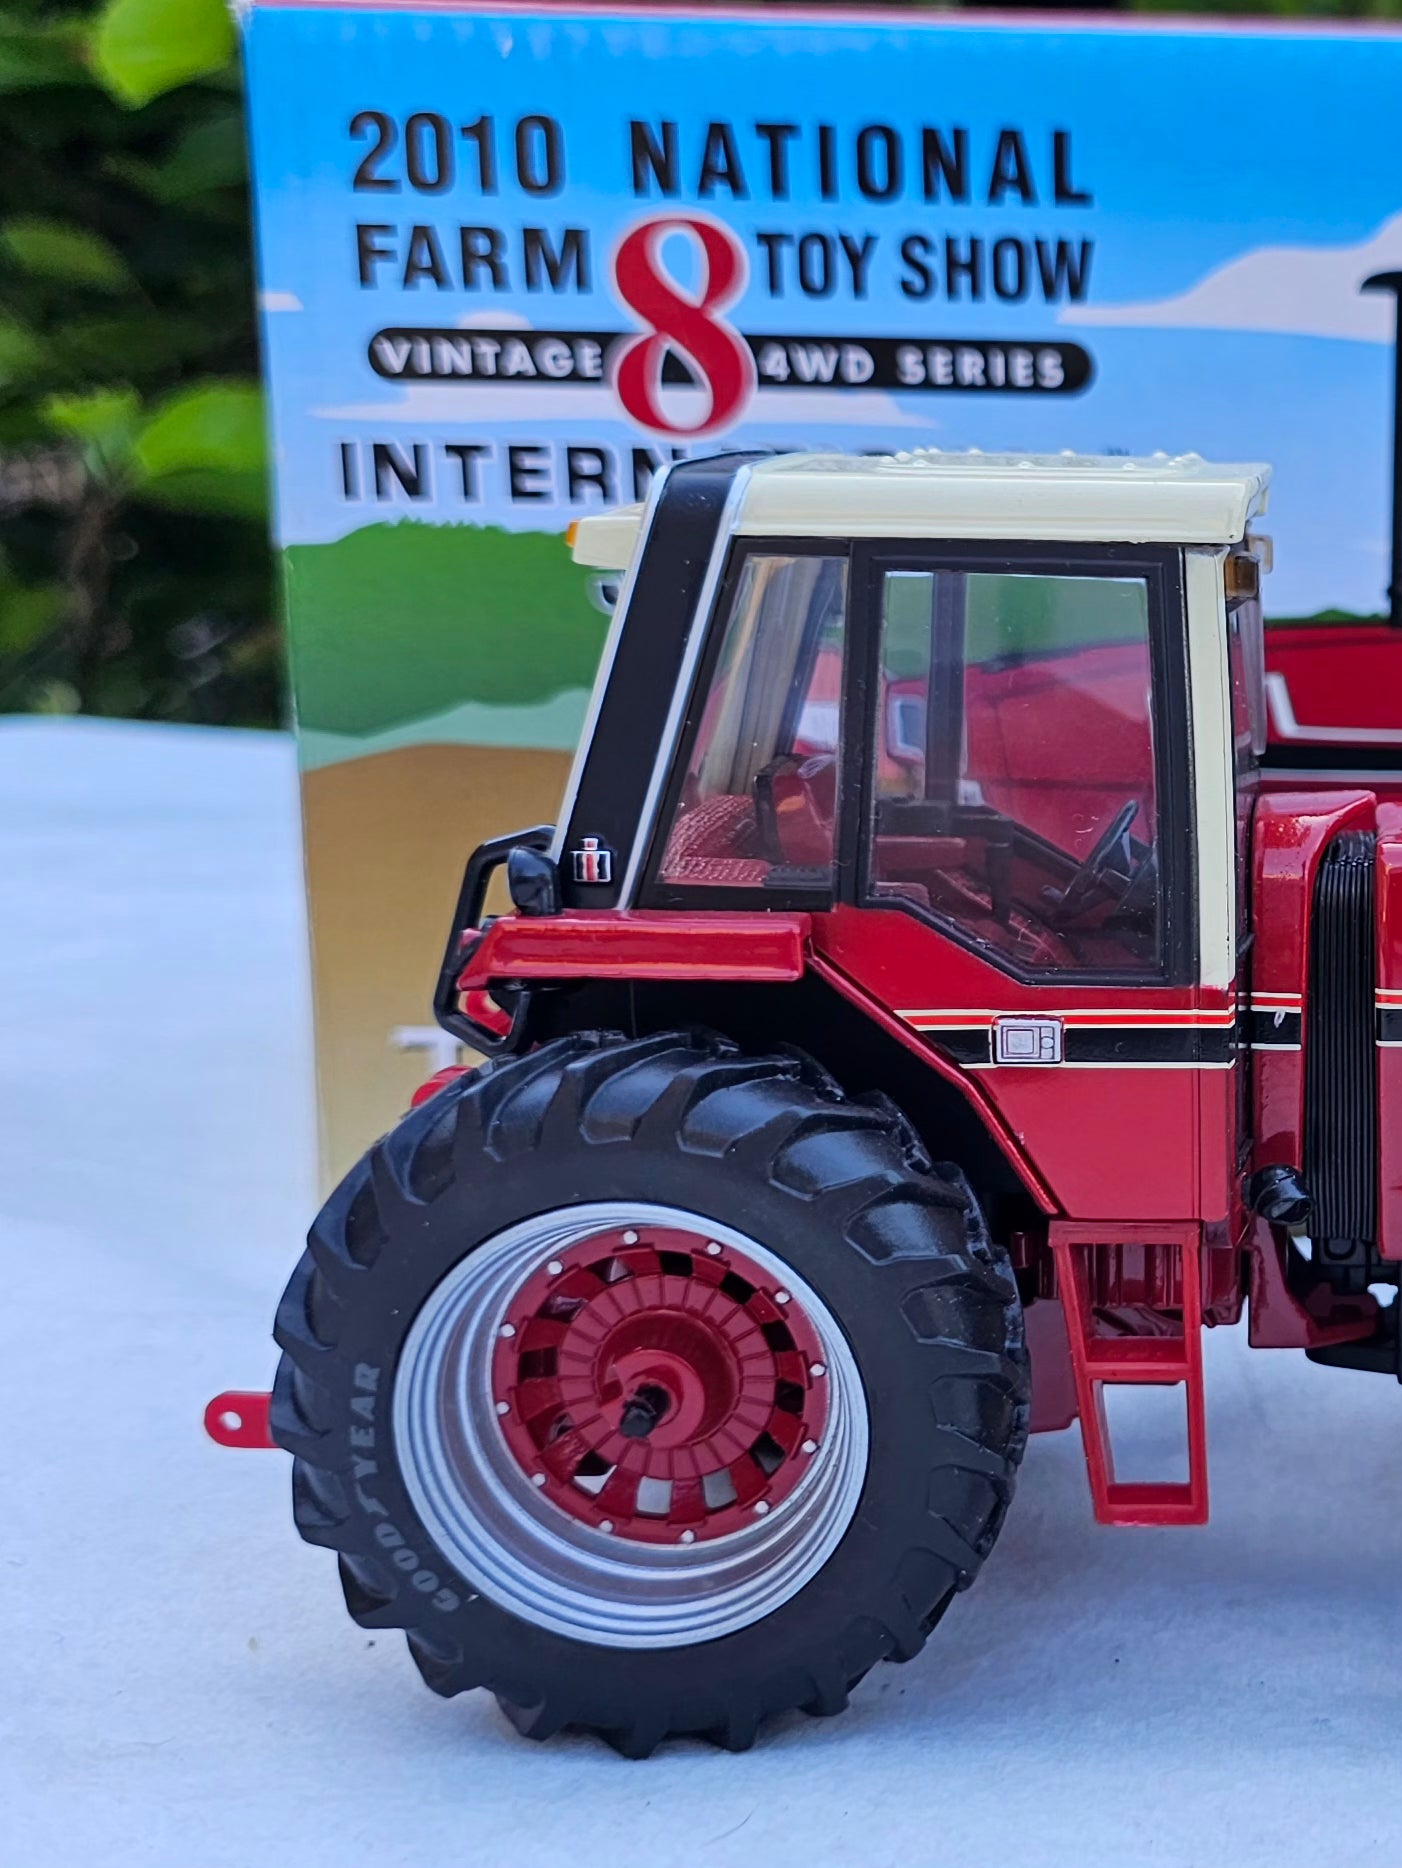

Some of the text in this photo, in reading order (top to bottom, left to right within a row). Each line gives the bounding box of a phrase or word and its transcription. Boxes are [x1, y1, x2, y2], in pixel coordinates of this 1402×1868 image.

[349, 110, 1096, 206] 2010 NATIONAL
[355, 217, 1096, 435] FARM 8 TOY SHOW
[375, 335, 1066, 390] VINTAGE 4WD SERIES
[350, 1361, 461, 1612] GOODYEAR
